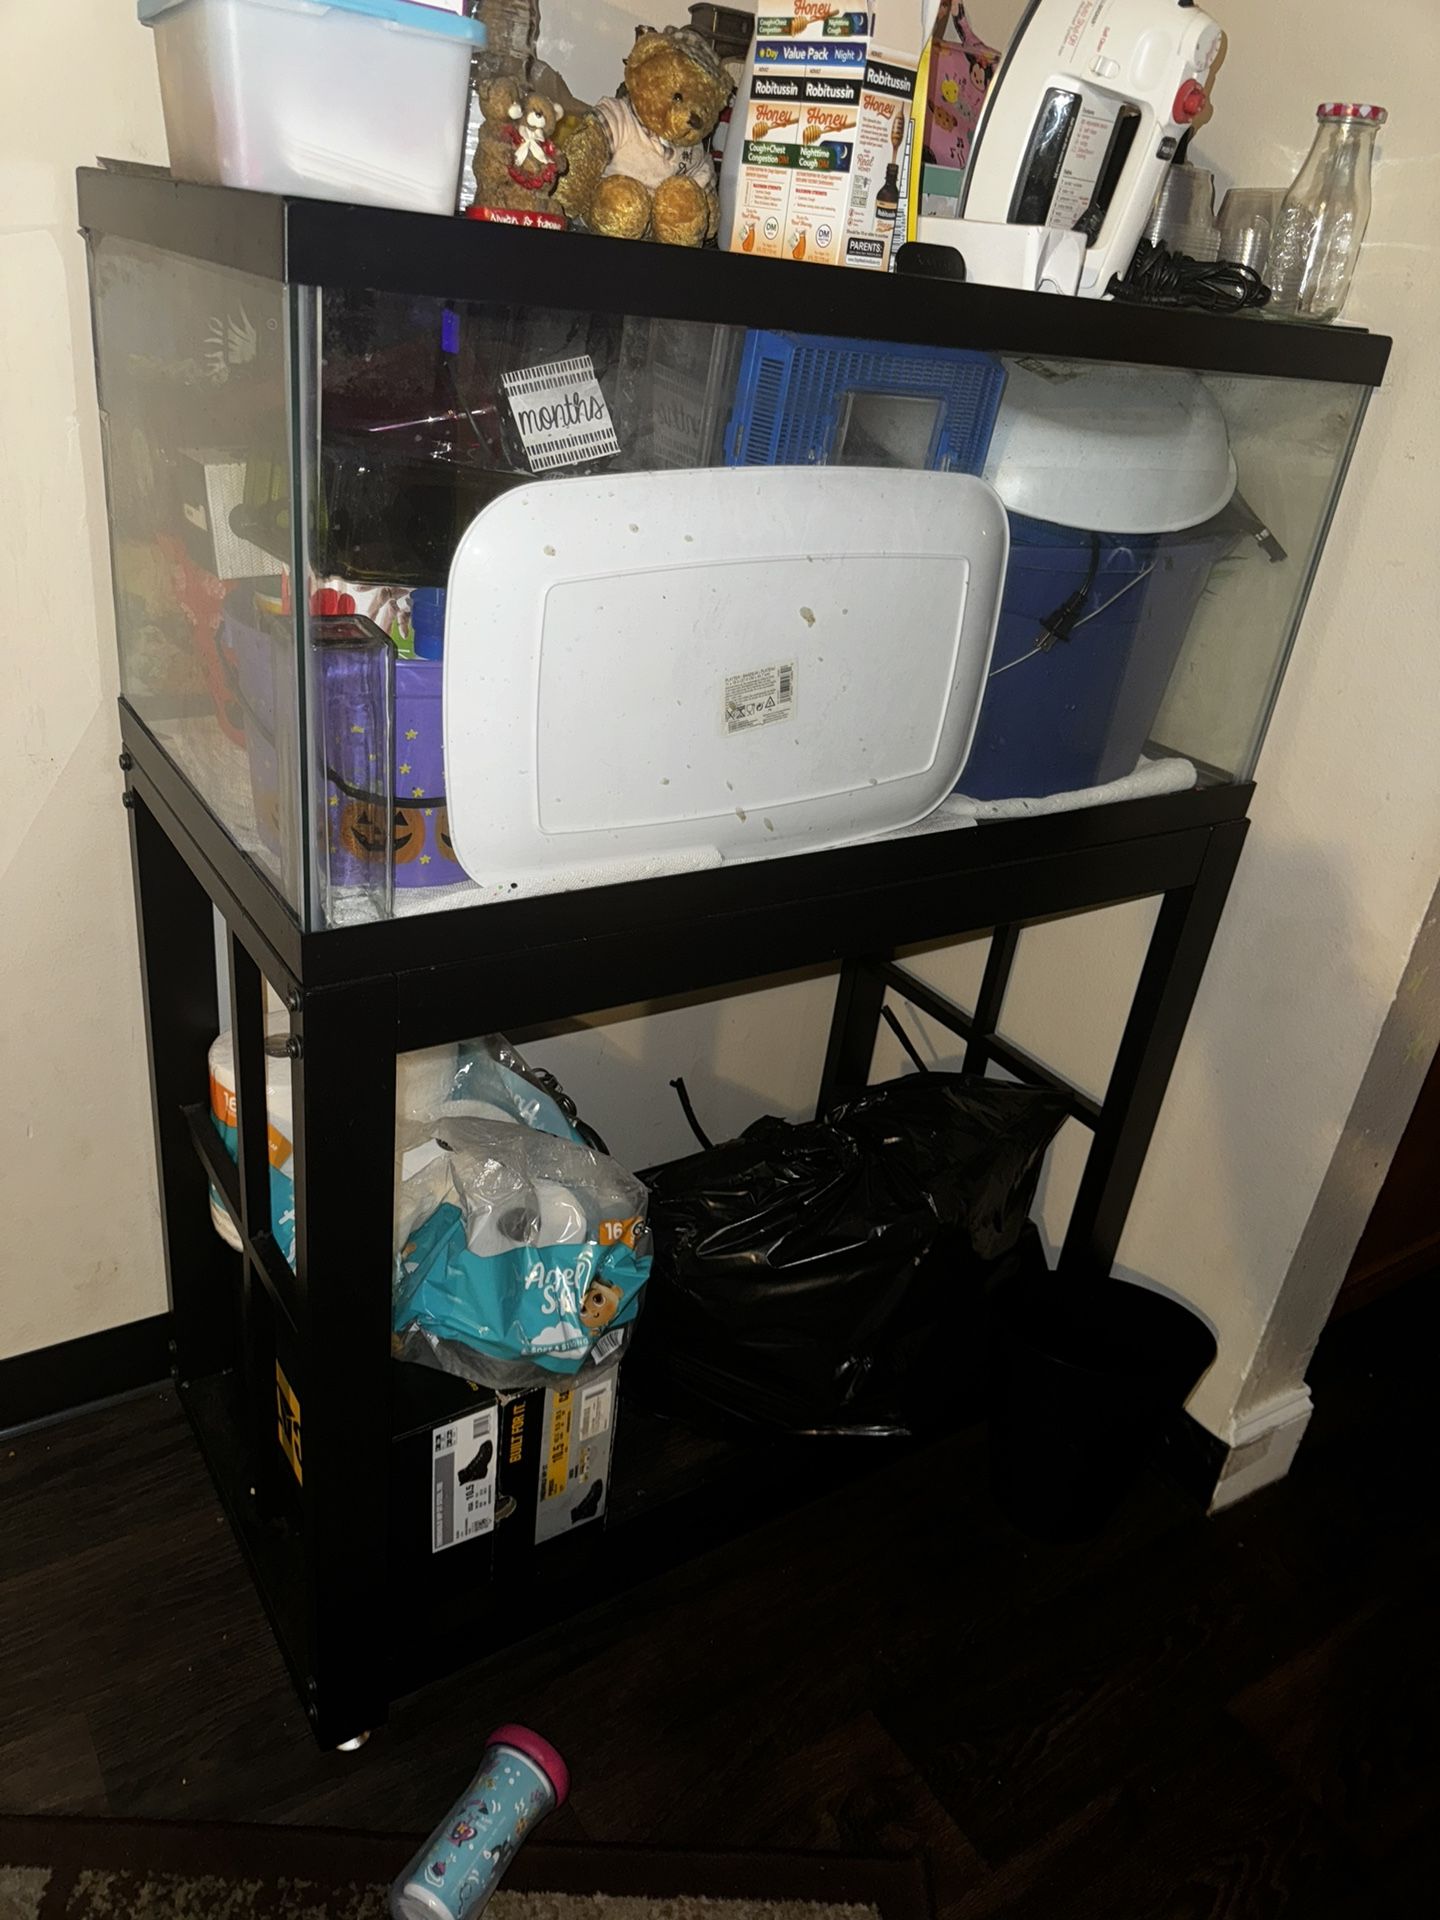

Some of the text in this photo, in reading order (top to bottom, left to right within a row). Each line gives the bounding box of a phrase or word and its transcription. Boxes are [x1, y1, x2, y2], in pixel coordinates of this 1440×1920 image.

[794, 0, 831, 20] Honey
[766, 48, 778, 60] Day
[783, 46, 829, 61] Value Pack
[834, 47, 855, 63] Night
[755, 81, 799, 96] Robitussin
[867, 68, 912, 92] Robitussin
[806, 82, 854, 99] Robitussin
[756, 104, 793, 128] Honey
[863, 95, 896, 120] Honey
[807, 107, 848, 132] Honey
[749, 143, 786, 155] Cough+Chest
[800, 147, 830, 159] Nighttime
[747, 153, 778, 164] Congestion
[799, 158, 818, 170] Cough
[818, 229, 830, 238] DM
[518, 392, 605, 436] months
[605, 1221, 623, 1240] 16
[512, 1415, 524, 1435] FOR
[509, 1436, 523, 1464] BUILT
